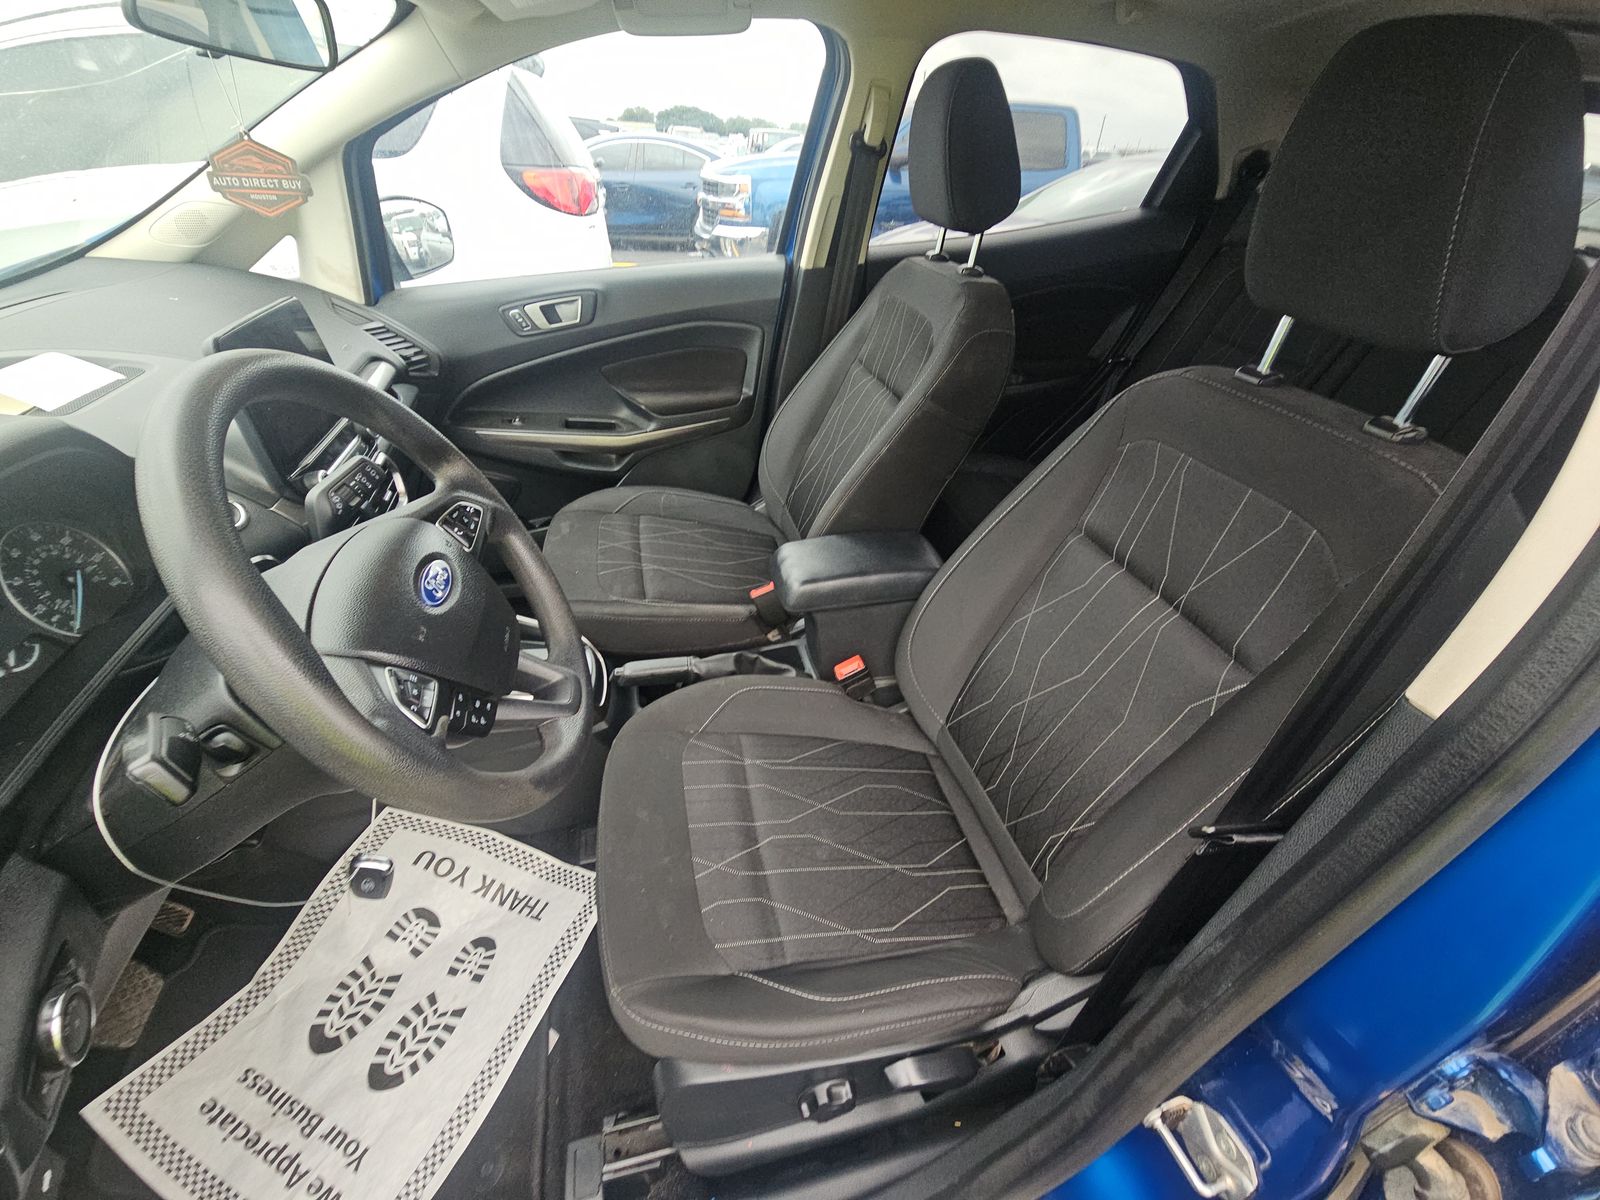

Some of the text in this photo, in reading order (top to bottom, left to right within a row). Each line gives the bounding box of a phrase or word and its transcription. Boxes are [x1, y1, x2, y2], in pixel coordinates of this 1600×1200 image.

[213, 177, 301, 189] AUTO DIRECT BUY
[412, 851, 549, 921] THANK YOU
[200, 1098, 310, 1189] Appreciate
[238, 1067, 370, 1173] Your Business
